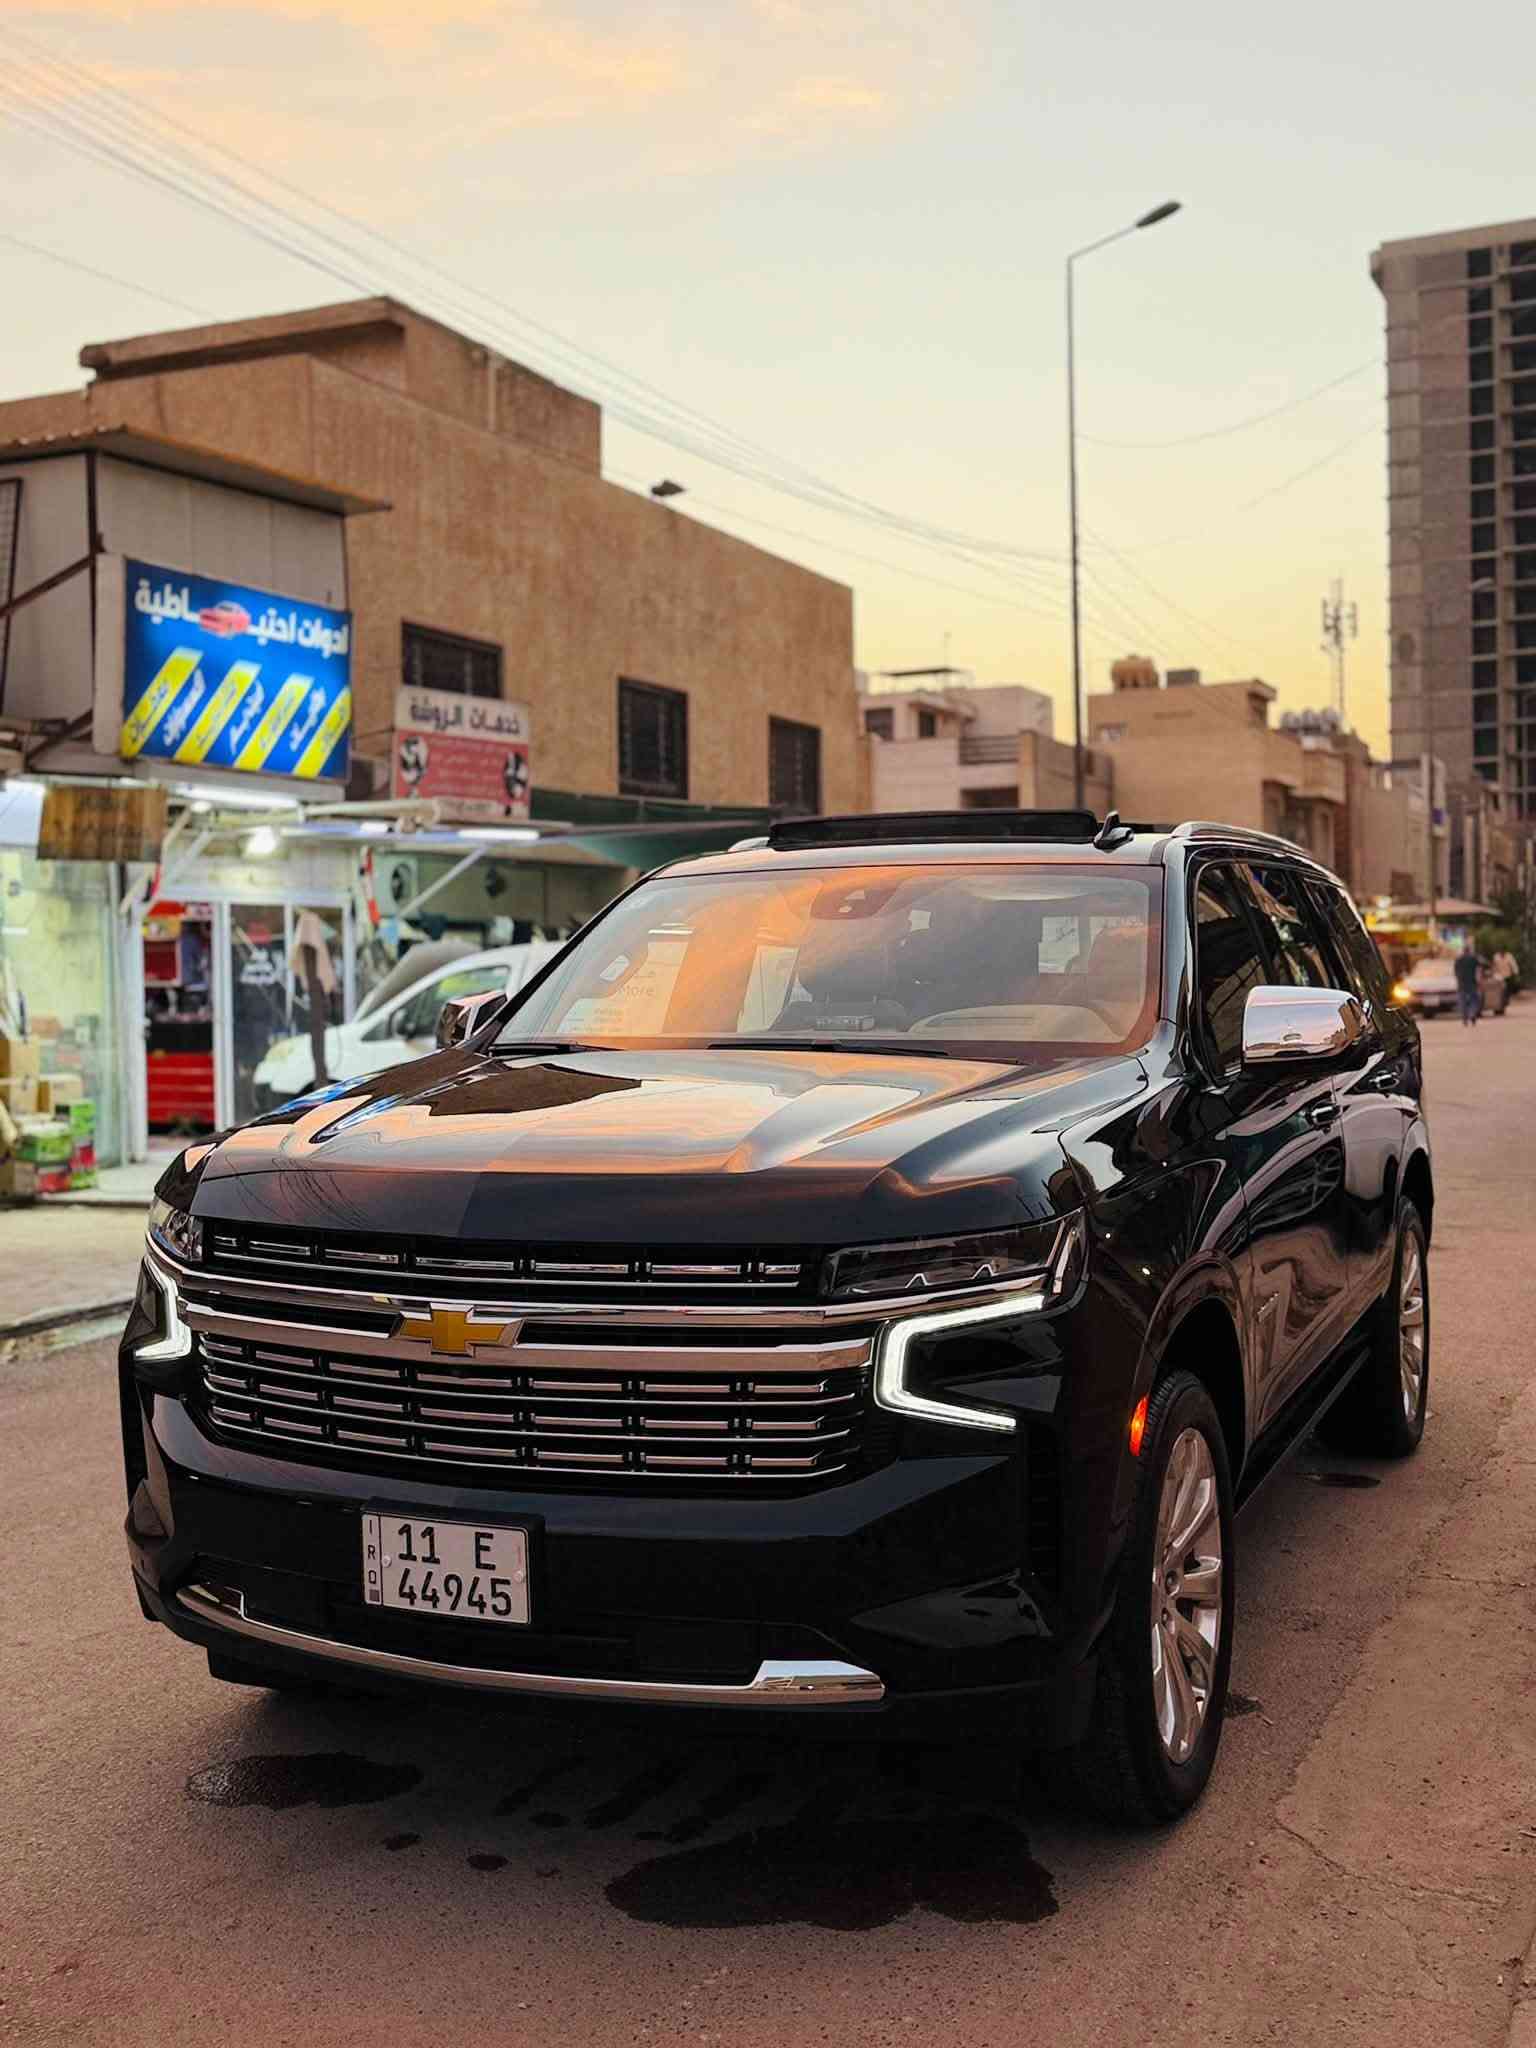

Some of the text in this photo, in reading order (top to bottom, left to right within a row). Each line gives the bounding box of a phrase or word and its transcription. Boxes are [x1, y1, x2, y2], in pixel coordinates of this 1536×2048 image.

[397, 1523, 496, 1571] 11 E
[398, 1567, 512, 1617] 44945
